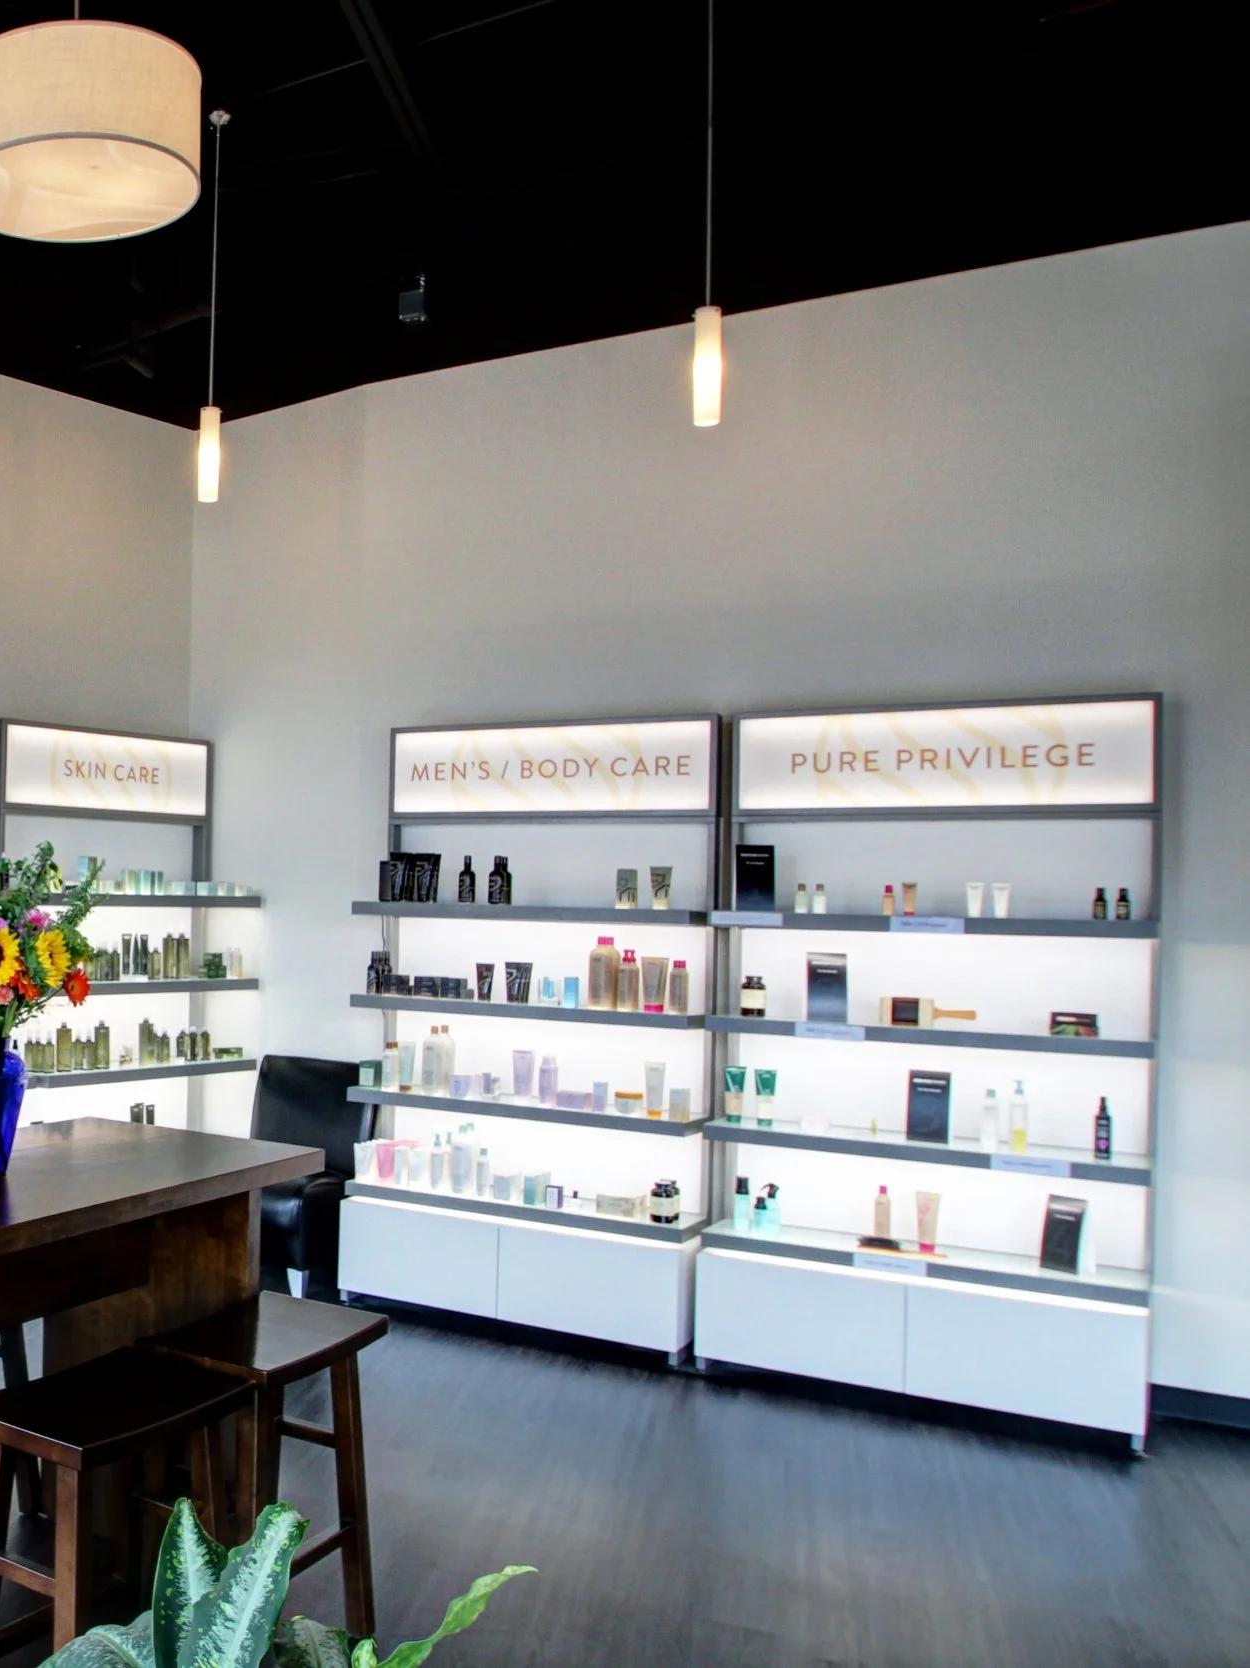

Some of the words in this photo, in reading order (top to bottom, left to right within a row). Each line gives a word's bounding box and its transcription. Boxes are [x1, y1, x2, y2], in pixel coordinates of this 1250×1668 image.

[520, 757, 599, 779] BODY
[610, 755, 692, 777] CARE
[791, 750, 881, 774] PURE
[896, 742, 1097, 771] PRIVILEGE
[64, 759, 106, 779] SKIN
[113, 764, 160, 785] CARE
